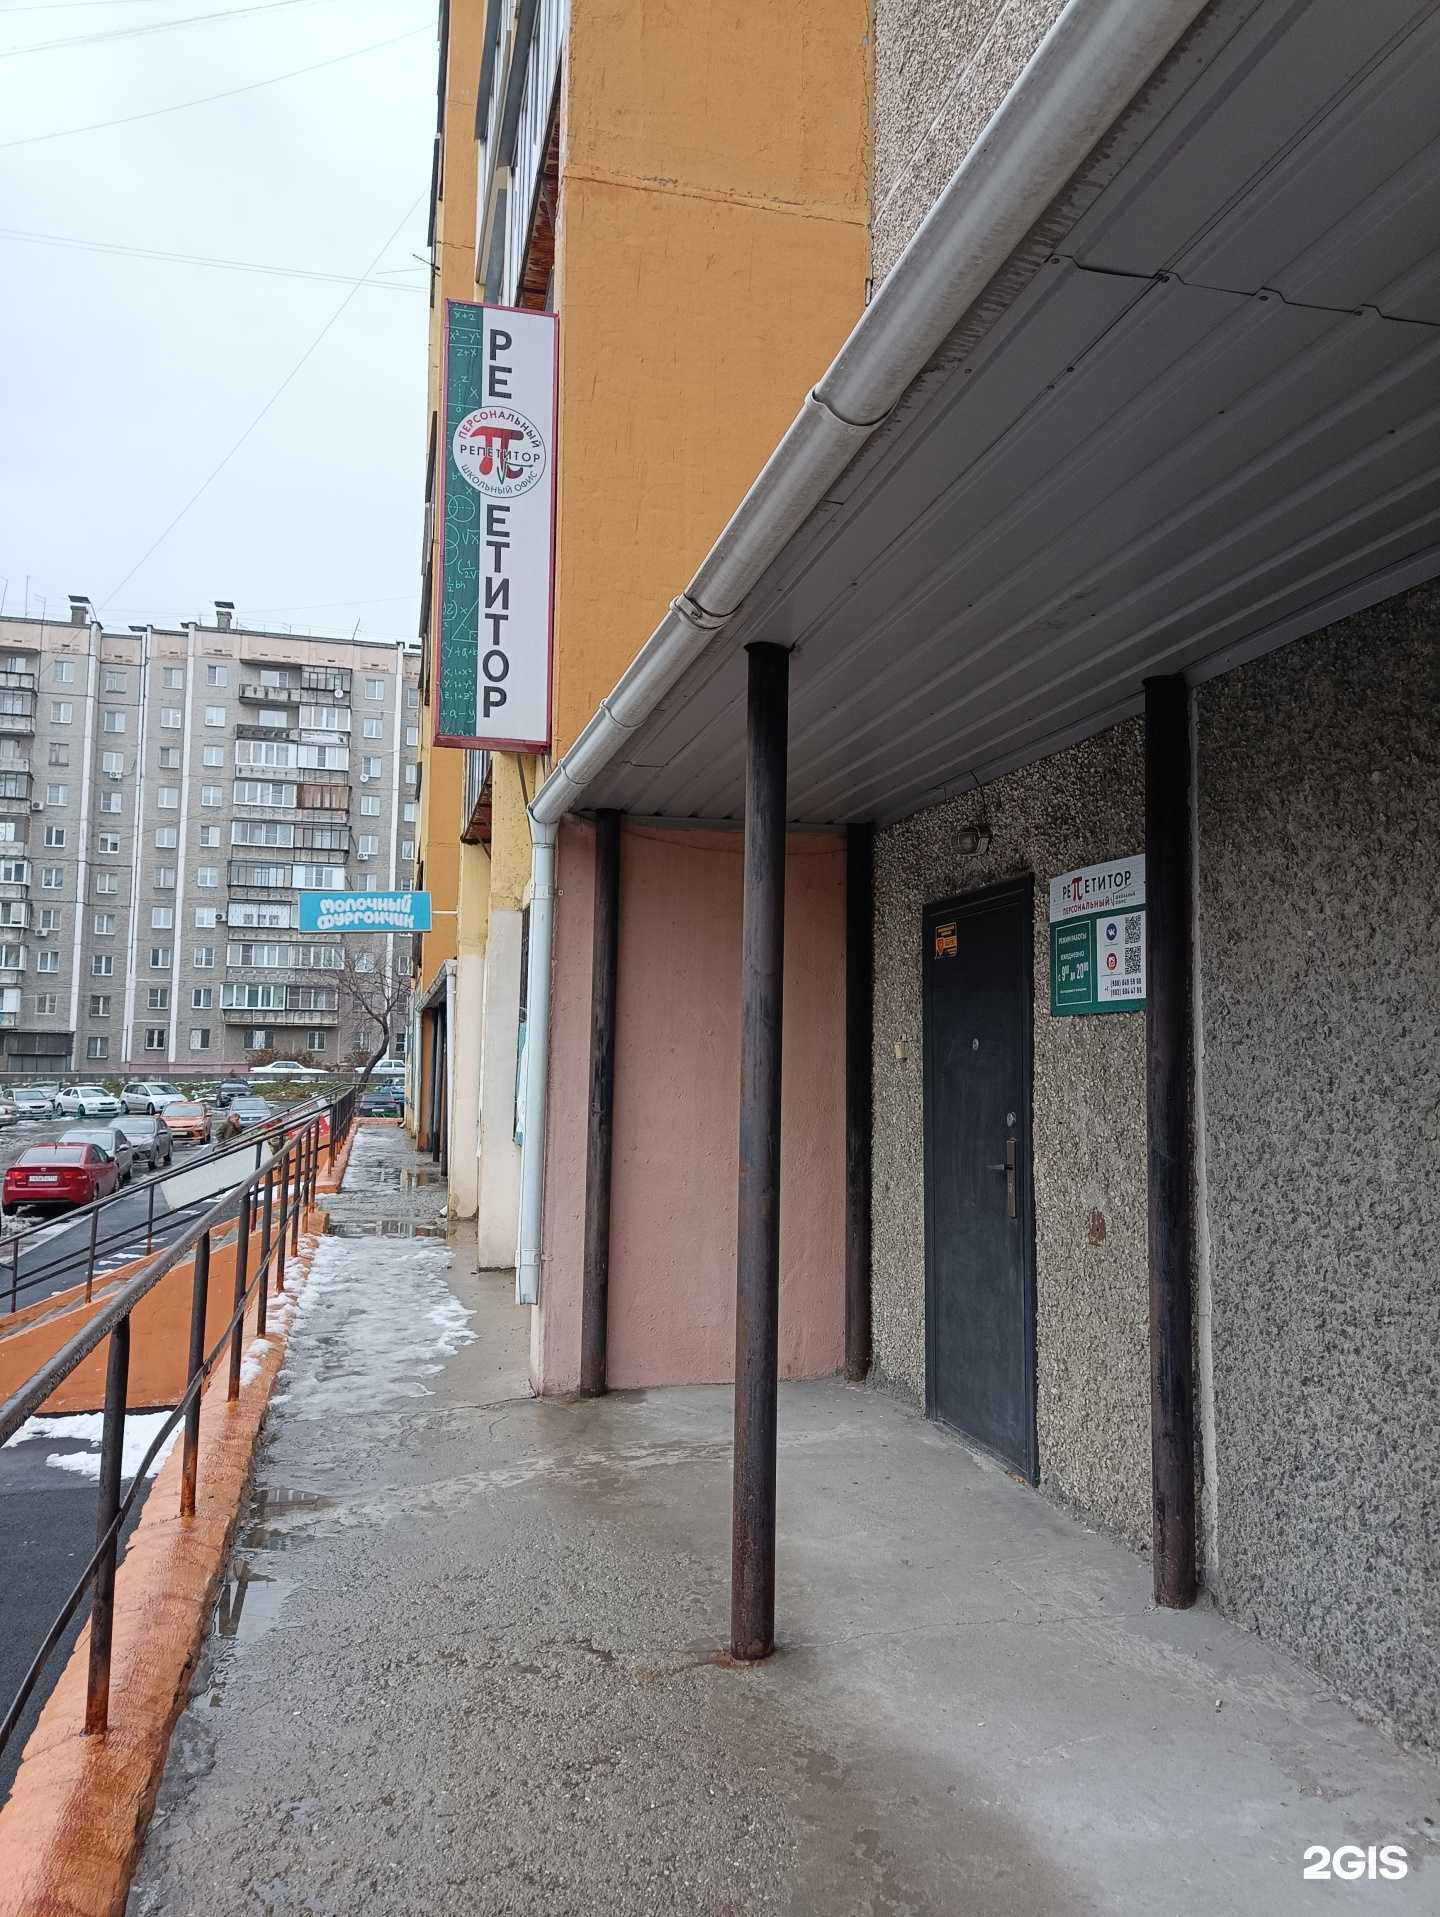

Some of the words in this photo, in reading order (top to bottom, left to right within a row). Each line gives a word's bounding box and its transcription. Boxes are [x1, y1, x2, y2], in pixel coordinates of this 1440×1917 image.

[458, 410, 542, 448] ПЕРСОНАЛЬНЫЙ
[460, 445, 540, 462] РЕПЕТИТОР
[461, 464, 513, 494] ШКОЛЬНЫЙ
[514, 470, 538, 491] ОФИС
[1063, 896, 1110, 916] ПЕРСОНАЛЬНЫЙ
